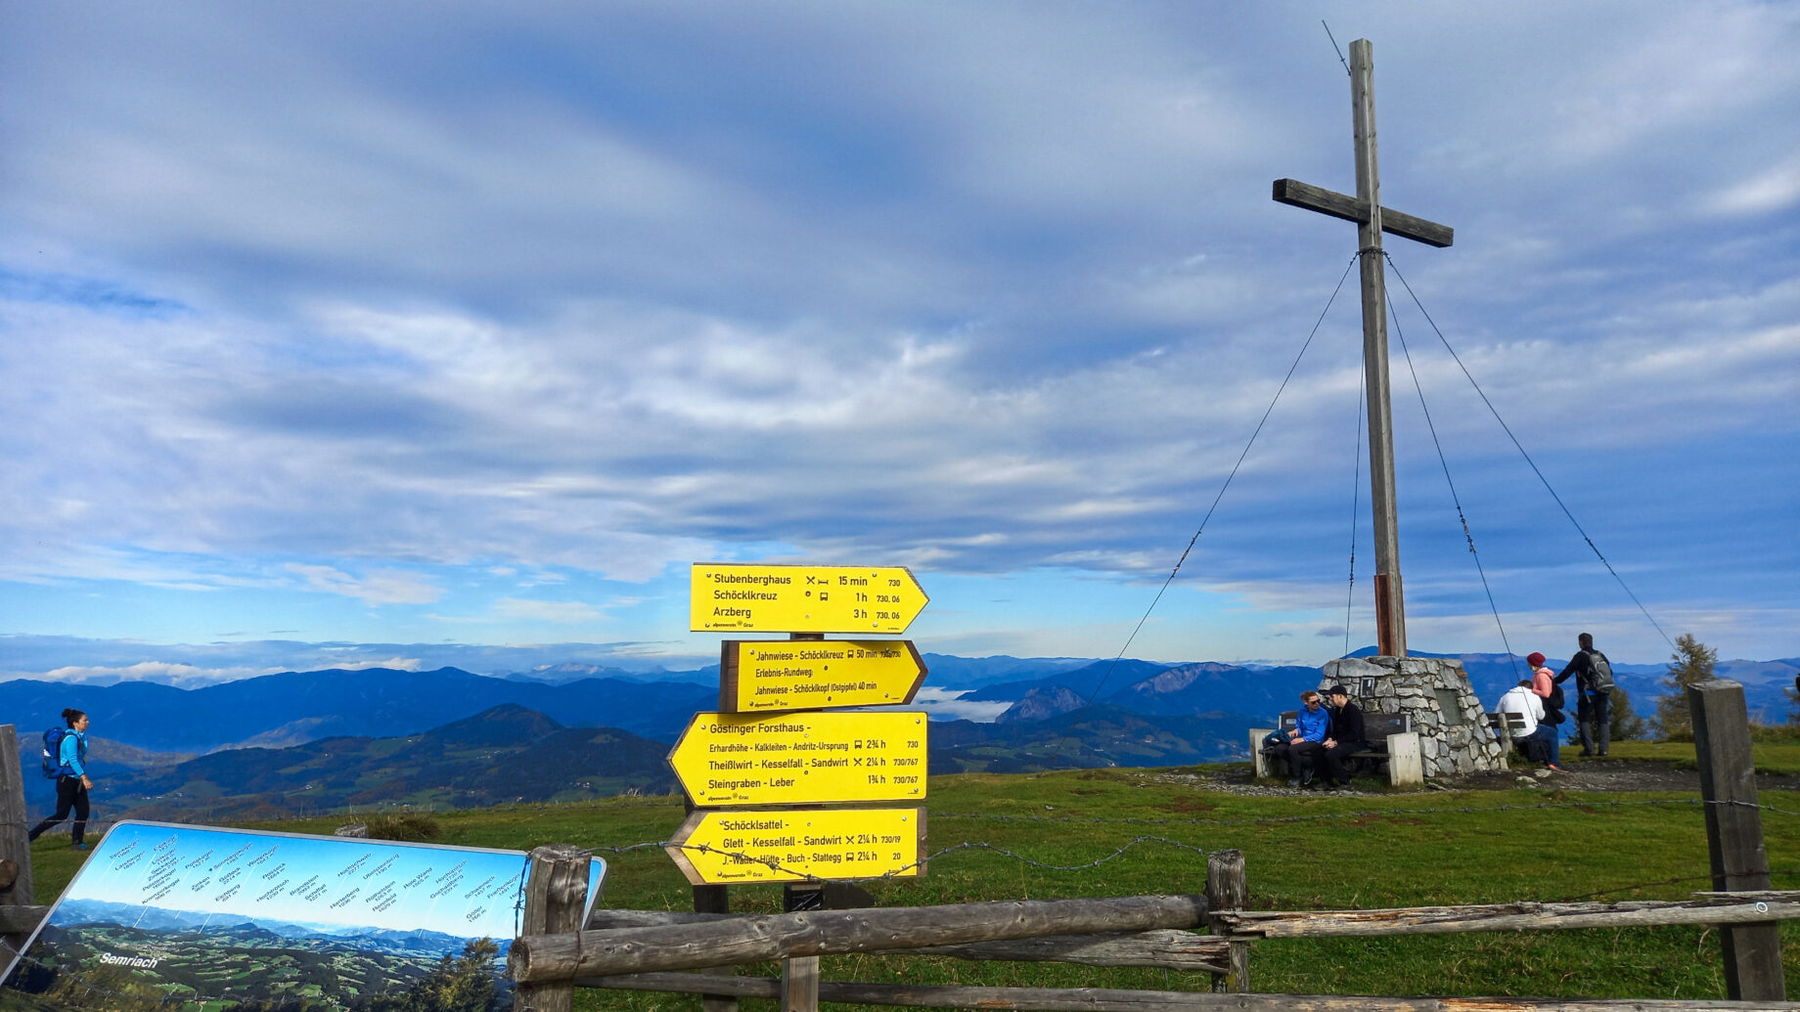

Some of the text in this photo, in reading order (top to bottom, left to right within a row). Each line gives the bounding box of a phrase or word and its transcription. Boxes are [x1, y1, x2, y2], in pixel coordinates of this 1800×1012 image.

[714, 574, 791, 586] Stubenberghaus
[839, 576, 867, 586] 15 min
[888, 579, 900, 587] 730
[714, 590, 777, 600] Schöcklkreuz
[856, 592, 867, 602] 1 h
[892, 595, 900, 603] 06
[713, 607, 751, 619] Arzberg
[854, 609, 867, 618] 3 h
[756, 651, 793, 661] Jahnwiese
[800, 650, 844, 660] Schöcklkreuz
[856, 649, 877, 658] 50 min
[755, 685, 788, 695] Jahnwiese
[794, 683, 830, 694] Schöcklkopf
[858, 681, 865, 690] 40
[866, 681, 877, 689] min
[710, 723, 756, 736] Göstinger
[758, 723, 804, 733] Forsthaus
[709, 744, 748, 752] Erhardhöhe
[755, 743, 787, 751] Kalkleiten
[793, 742, 848, 752] Andritz-Ursprung
[881, 740, 886, 748] h
[709, 760, 752, 770] Theißlwirt
[762, 759, 803, 768] Kesselfall
[811, 757, 848, 767] Sandwirt
[880, 757, 886, 766] h
[893, 758, 918, 766] 730/767
[708, 779, 761, 790] Steingraben
[770, 777, 795, 787] Leber
[880, 775, 886, 784] h
[893, 776, 918, 784] 730/767
[723, 820, 783, 831] Schöcklsattel
[723, 838, 744, 848] Glett
[753, 836, 795, 847] Kesselfall
[804, 836, 842, 846] Sandwirt
[872, 834, 877, 844] h
[787, 854, 805, 863] Buch
[812, 853, 841, 864] Stattegg
[872, 851, 877, 861] h
[893, 852, 901, 860] 20
[100, 952, 158, 968] Semriach
